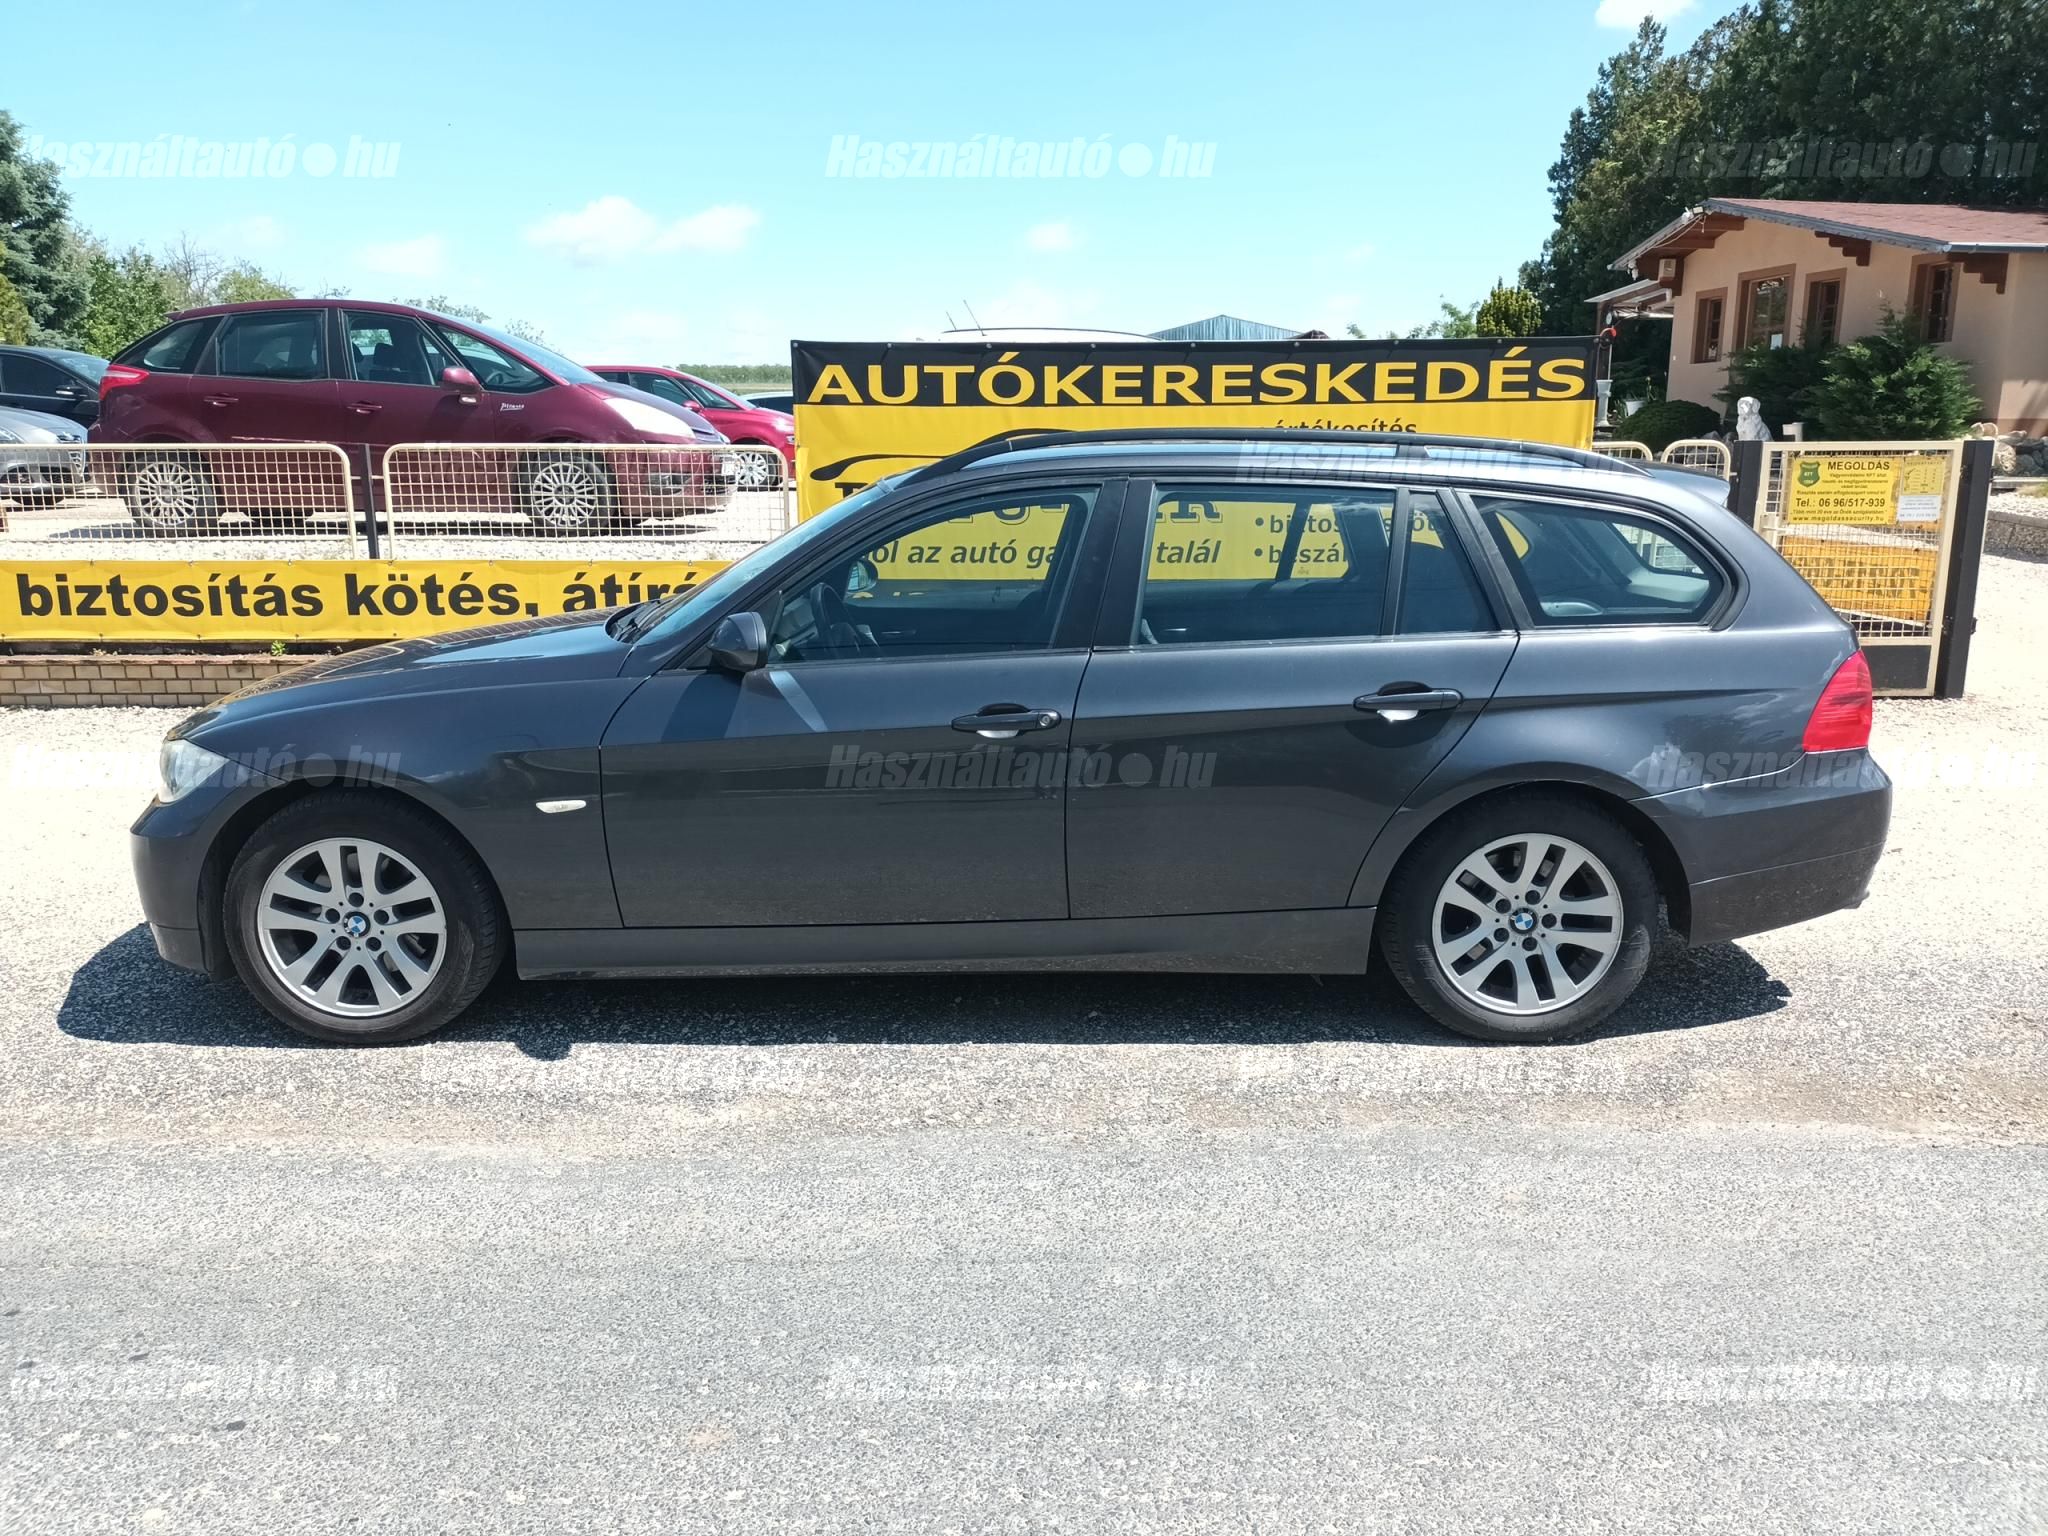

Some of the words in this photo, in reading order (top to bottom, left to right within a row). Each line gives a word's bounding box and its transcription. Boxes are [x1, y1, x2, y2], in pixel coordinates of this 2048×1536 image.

[807, 346, 1587, 405] AUTÓKERESKEDÉS
[1275, 418, 1417, 433] étéksítés
[1827, 460, 1890, 470] MEGOLDÁS
[1818, 498, 1830, 507] 06
[1833, 498, 1885, 507] 96/517-939
[908, 545, 942, 563] az
[951, 539, 1017, 564] autó
[1155, 540, 1222, 564] talál
[17, 572, 324, 617] biztosítás
[347, 572, 539, 618] kötés,
